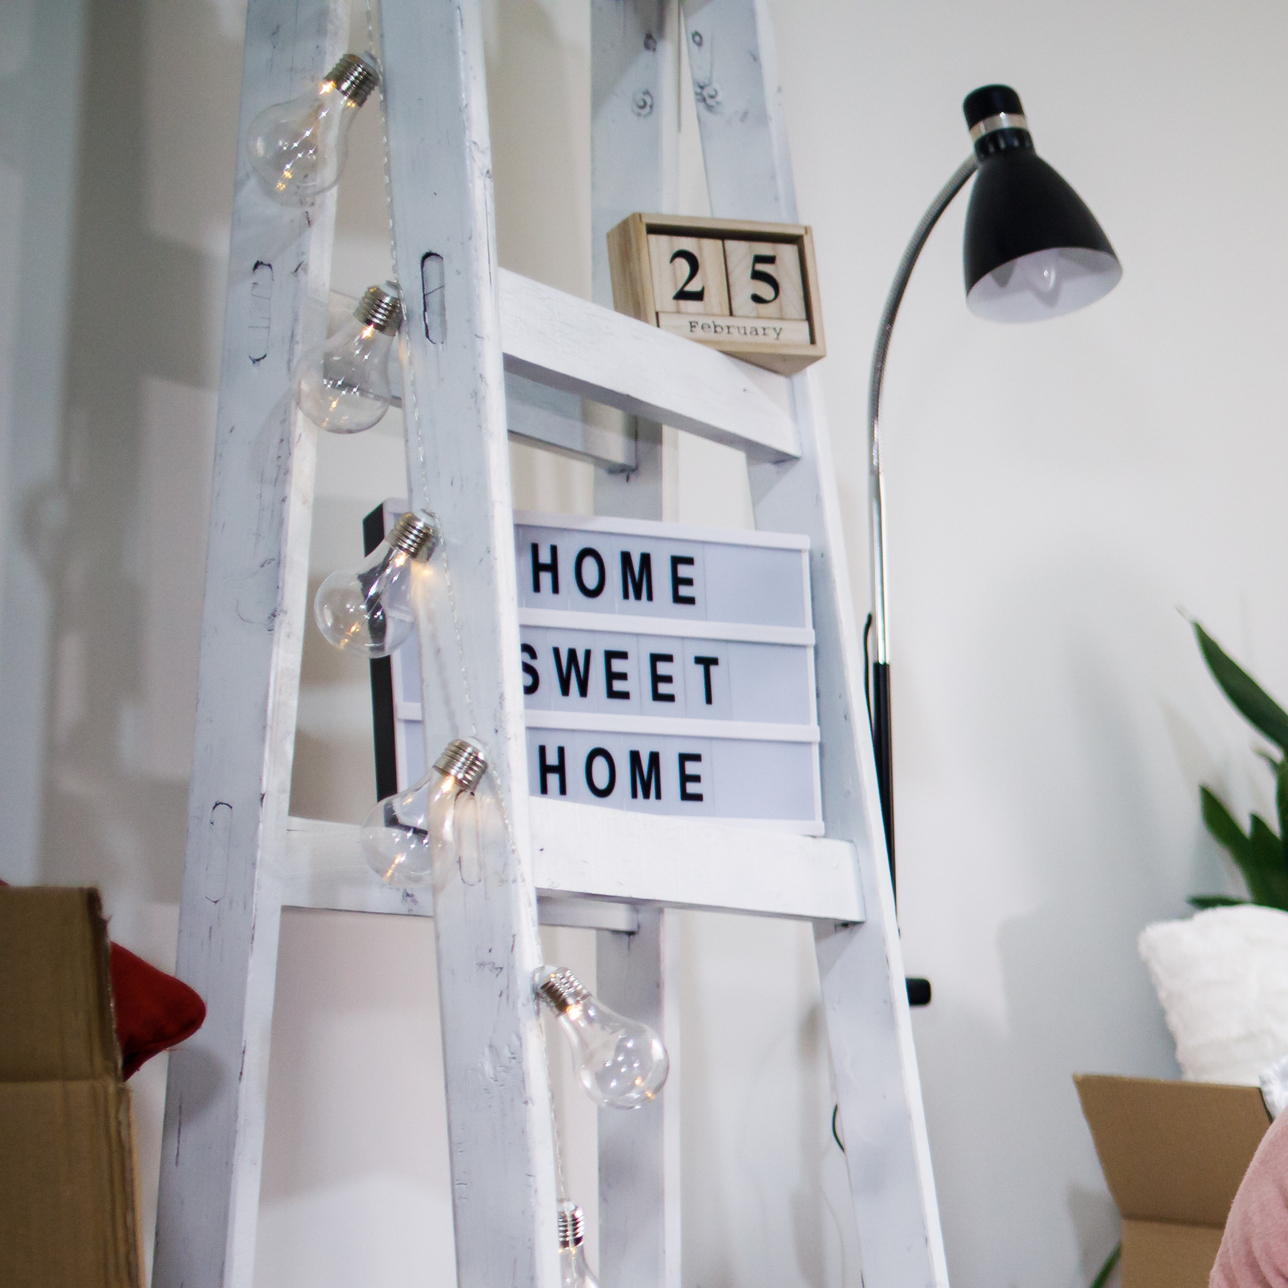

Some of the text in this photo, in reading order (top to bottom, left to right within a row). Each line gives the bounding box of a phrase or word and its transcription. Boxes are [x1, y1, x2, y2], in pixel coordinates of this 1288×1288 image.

[688, 320, 783, 340] February
[531, 542, 696, 605] HOME
[520, 643, 719, 705] SWEET
[539, 745, 704, 802] HOME
